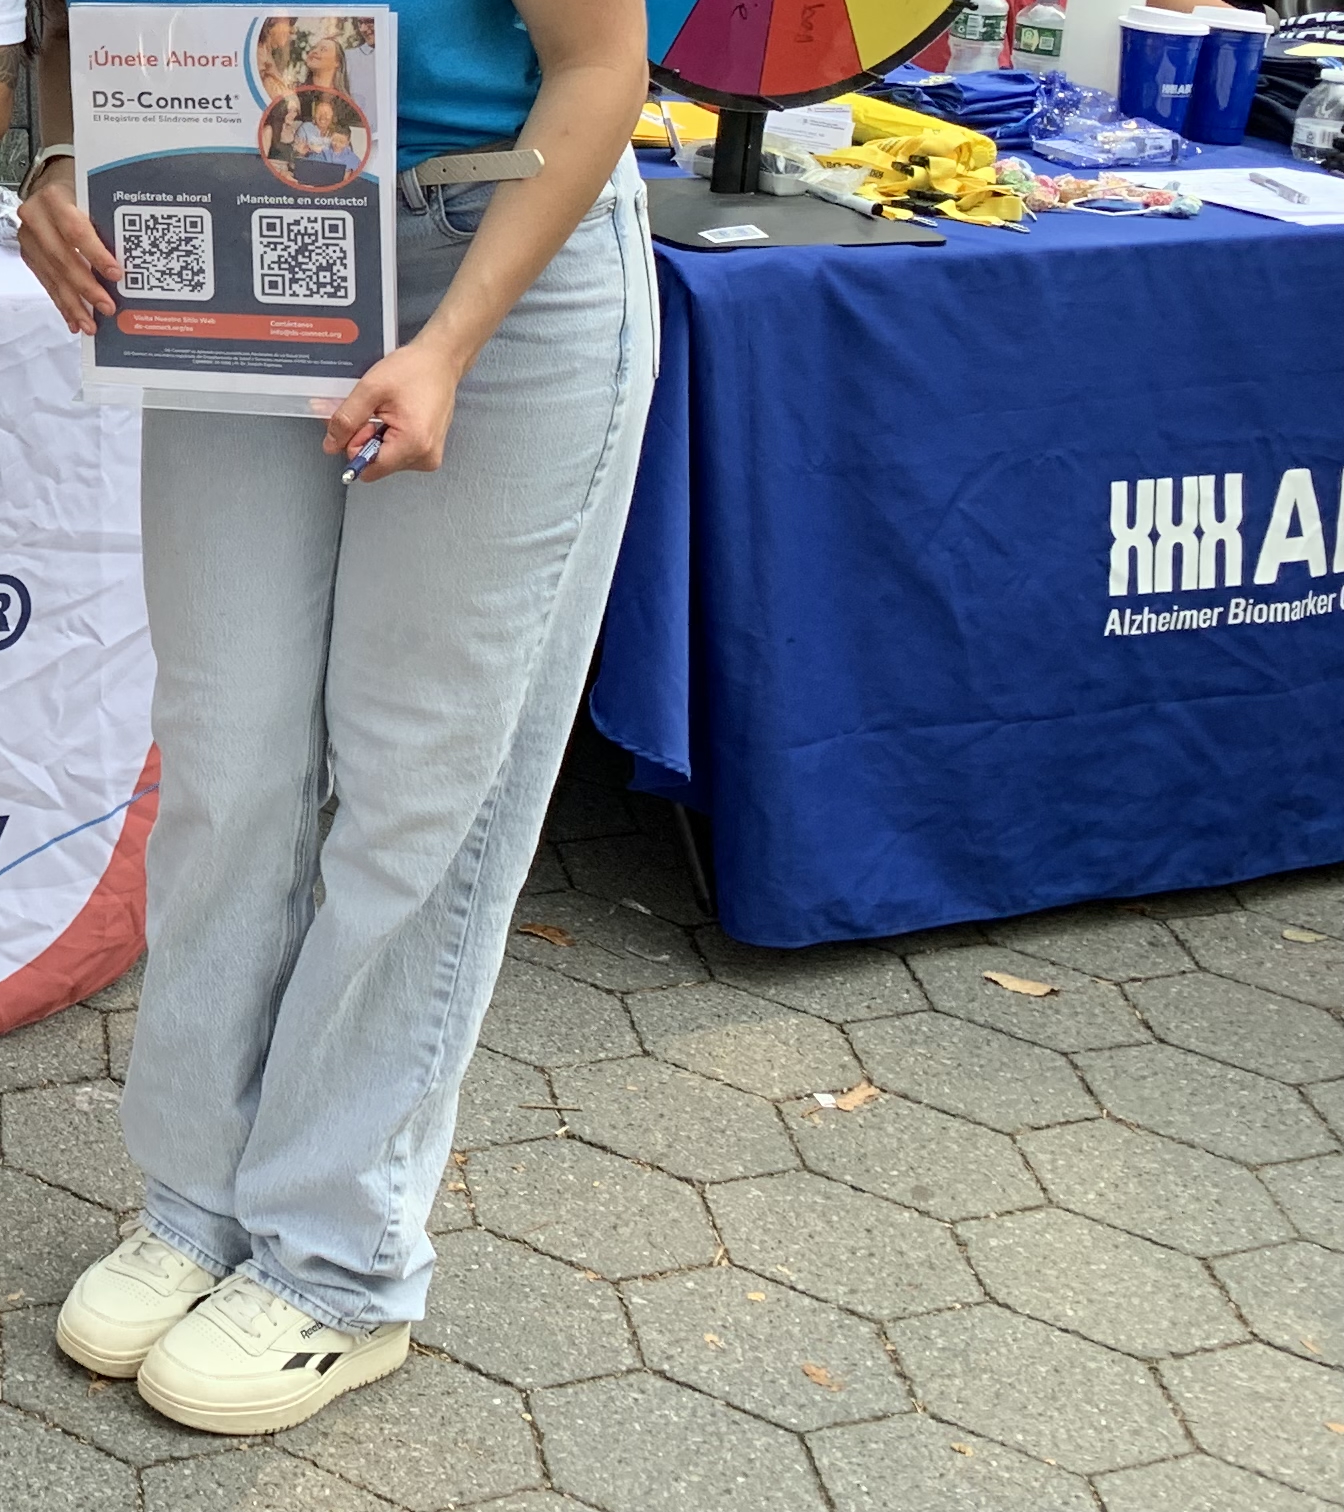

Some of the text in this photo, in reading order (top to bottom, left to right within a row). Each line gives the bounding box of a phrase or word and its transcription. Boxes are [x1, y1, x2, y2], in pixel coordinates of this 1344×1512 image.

[88, 45, 240, 70] ¡Únete Ahora!
[93, 114, 102, 122] El
[103, 114, 141, 124] Registro
[142, 115, 157, 123] del
[216, 116, 243, 124] Down
[176, 192, 212, 203] ahora!
[237, 194, 368, 207] ¡Mantente en contacto!
[1103, 589, 1337, 637] Alzheimer Biomarker
